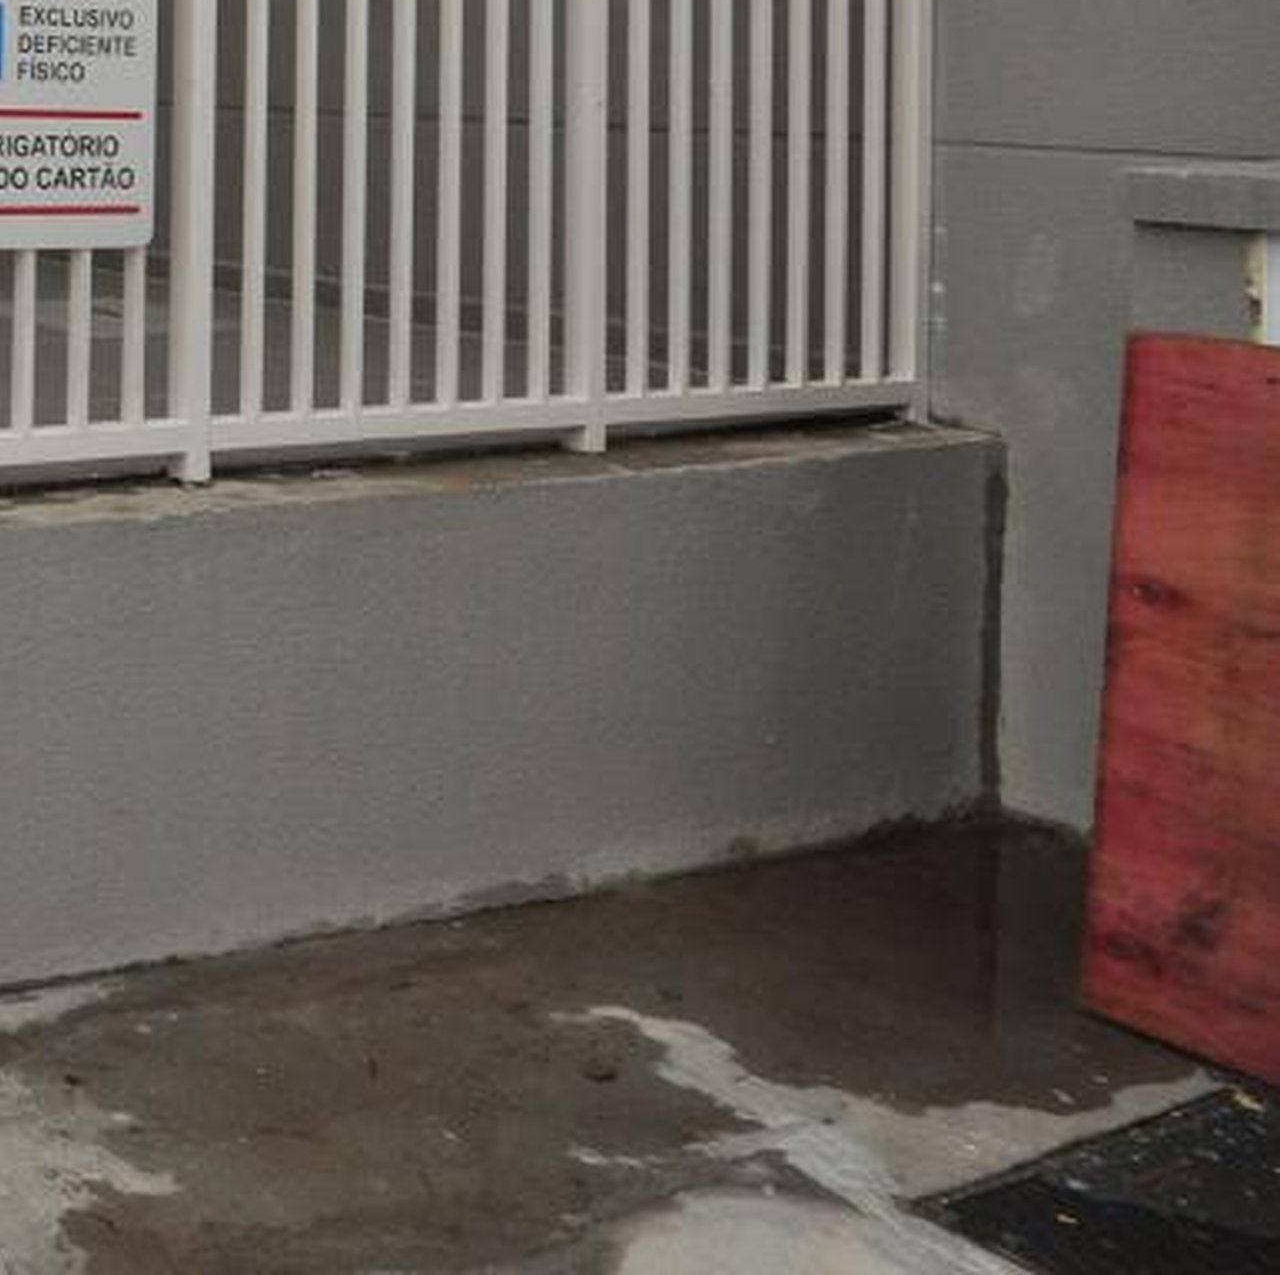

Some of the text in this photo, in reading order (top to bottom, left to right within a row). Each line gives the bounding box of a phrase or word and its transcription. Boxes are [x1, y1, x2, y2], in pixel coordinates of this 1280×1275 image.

[19, 5, 134, 29] EXCLUSIVO
[17, 34, 137, 56] DEFICIENTE
[17, 57, 85, 82] FÍSICO
[36, 162, 135, 189] CARTÃO
